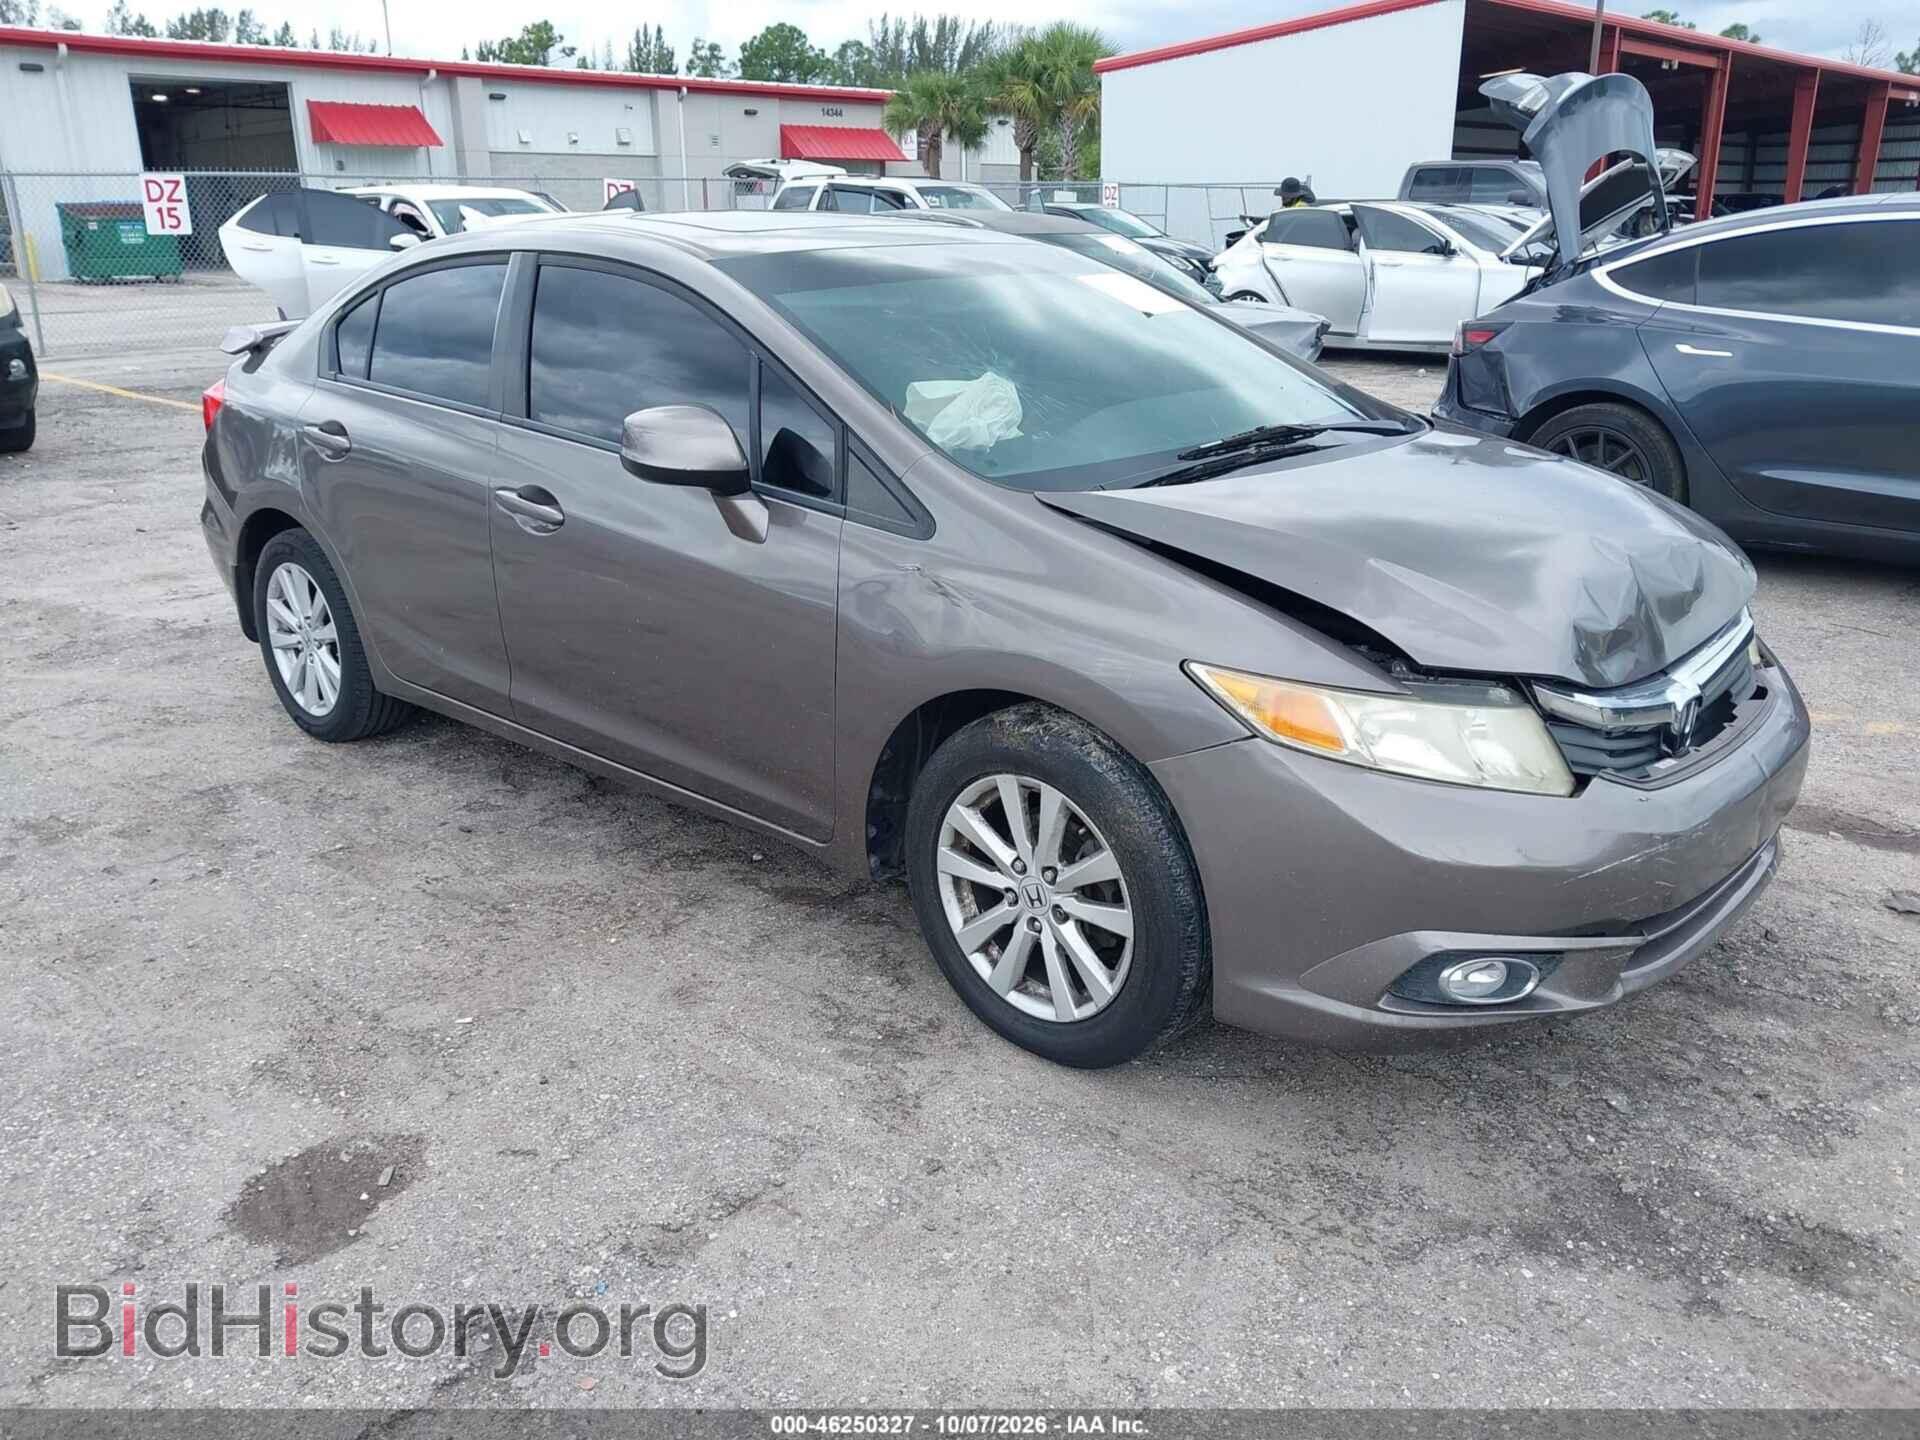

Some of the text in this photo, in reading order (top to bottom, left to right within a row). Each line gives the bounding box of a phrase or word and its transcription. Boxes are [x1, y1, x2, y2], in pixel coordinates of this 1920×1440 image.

[821, 107, 843, 117] 14344
[144, 179, 183, 202] DZ
[1104, 185, 1117, 200] DZ
[156, 206, 181, 230] 15
